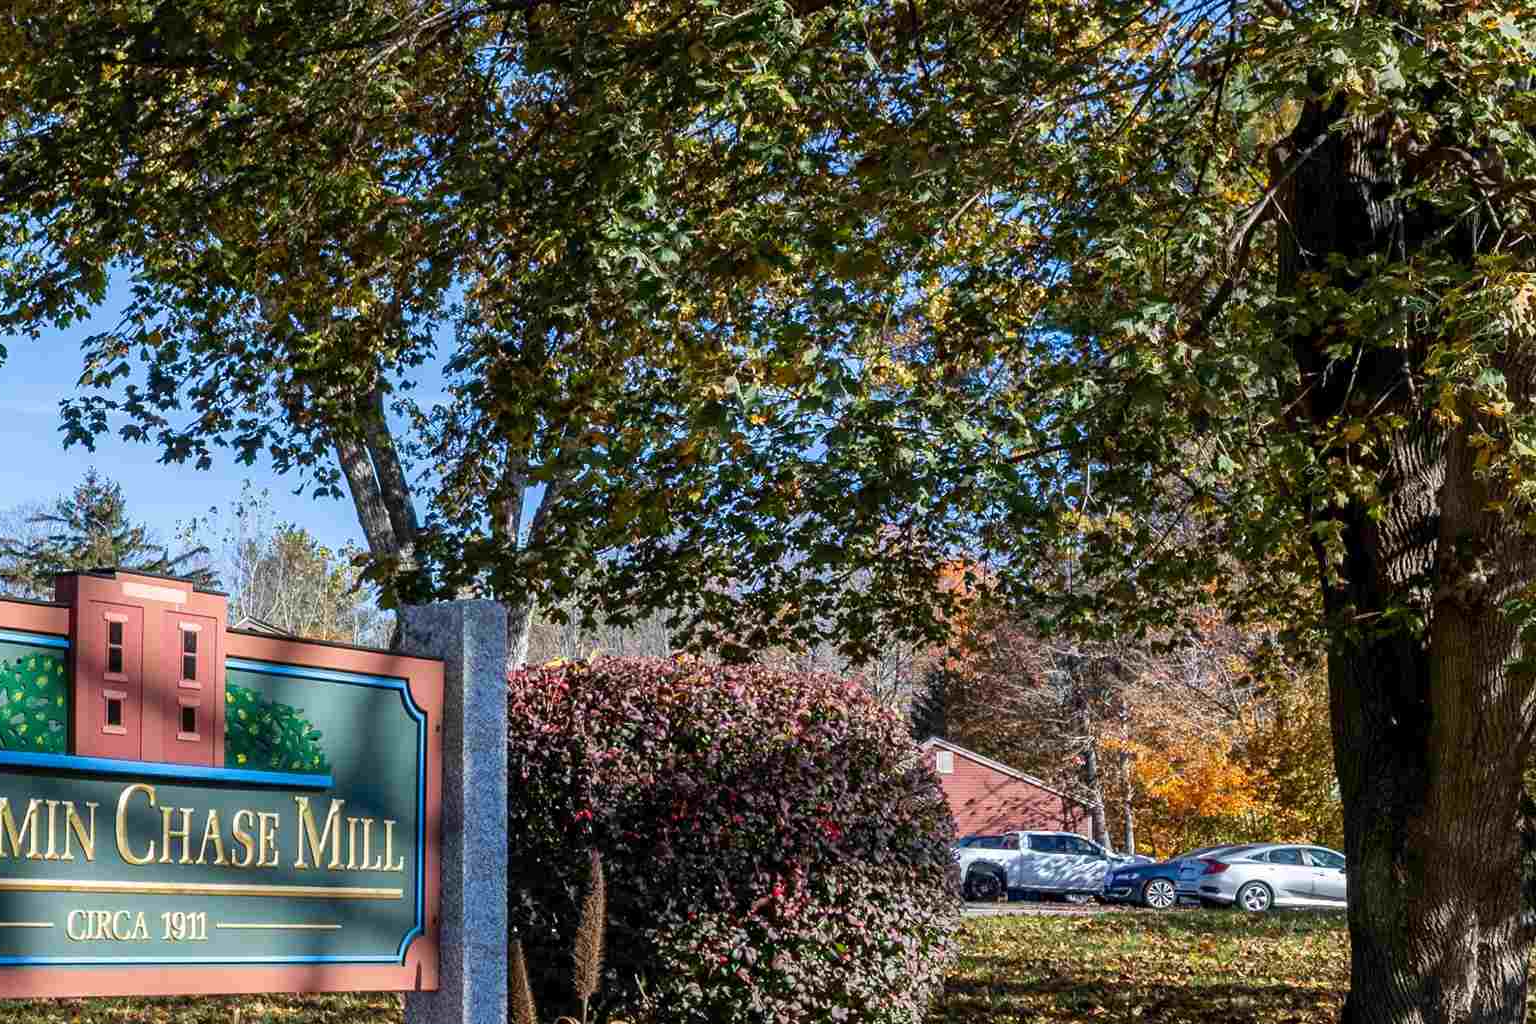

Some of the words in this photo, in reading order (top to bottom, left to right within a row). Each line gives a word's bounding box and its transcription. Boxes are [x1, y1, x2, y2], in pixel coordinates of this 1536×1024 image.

[115, 782, 280, 868] CHASE
[293, 796, 404, 873] MILL
[66, 909, 150, 942] CIRCA
[161, 910, 208, 942] 1911
